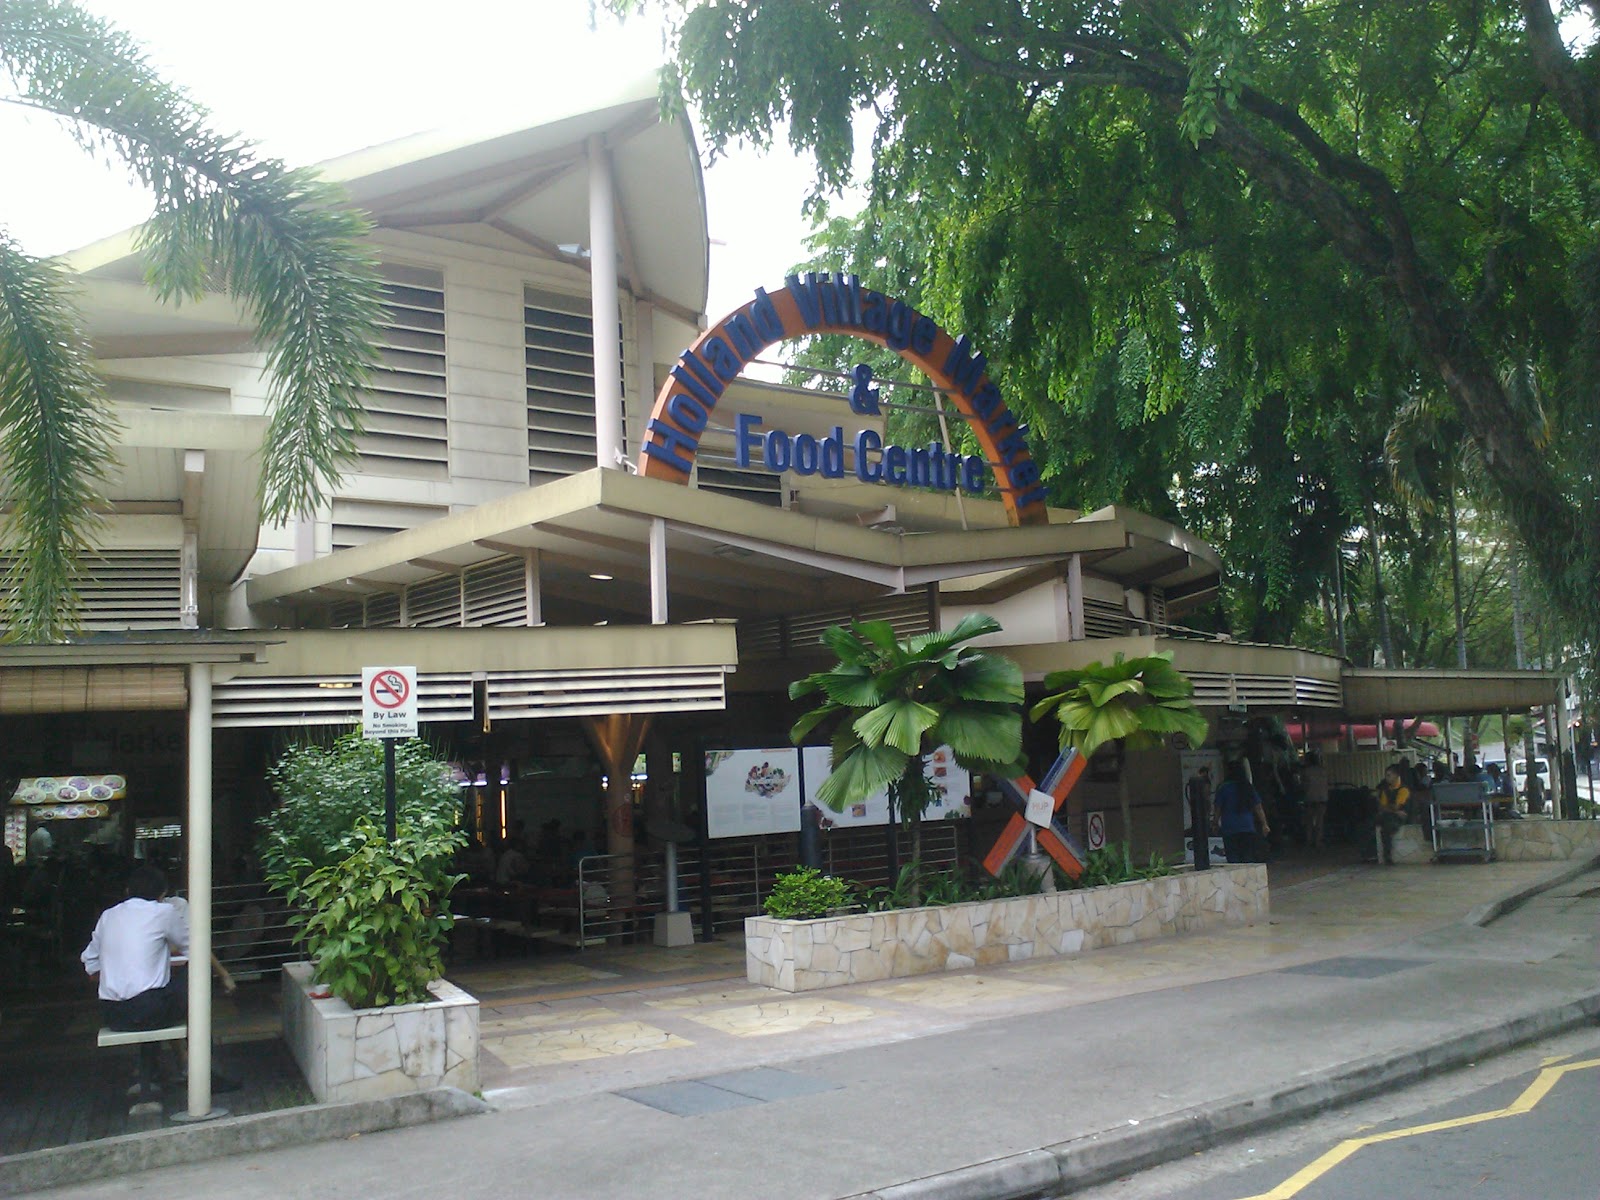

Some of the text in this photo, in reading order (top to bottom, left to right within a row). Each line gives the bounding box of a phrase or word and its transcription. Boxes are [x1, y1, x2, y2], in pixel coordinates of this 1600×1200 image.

[641, 272, 1050, 508] Holland Village Market
[848, 363, 882, 416] &
[736, 414, 985, 493] Food Centre
[373, 711, 407, 720] By Law
